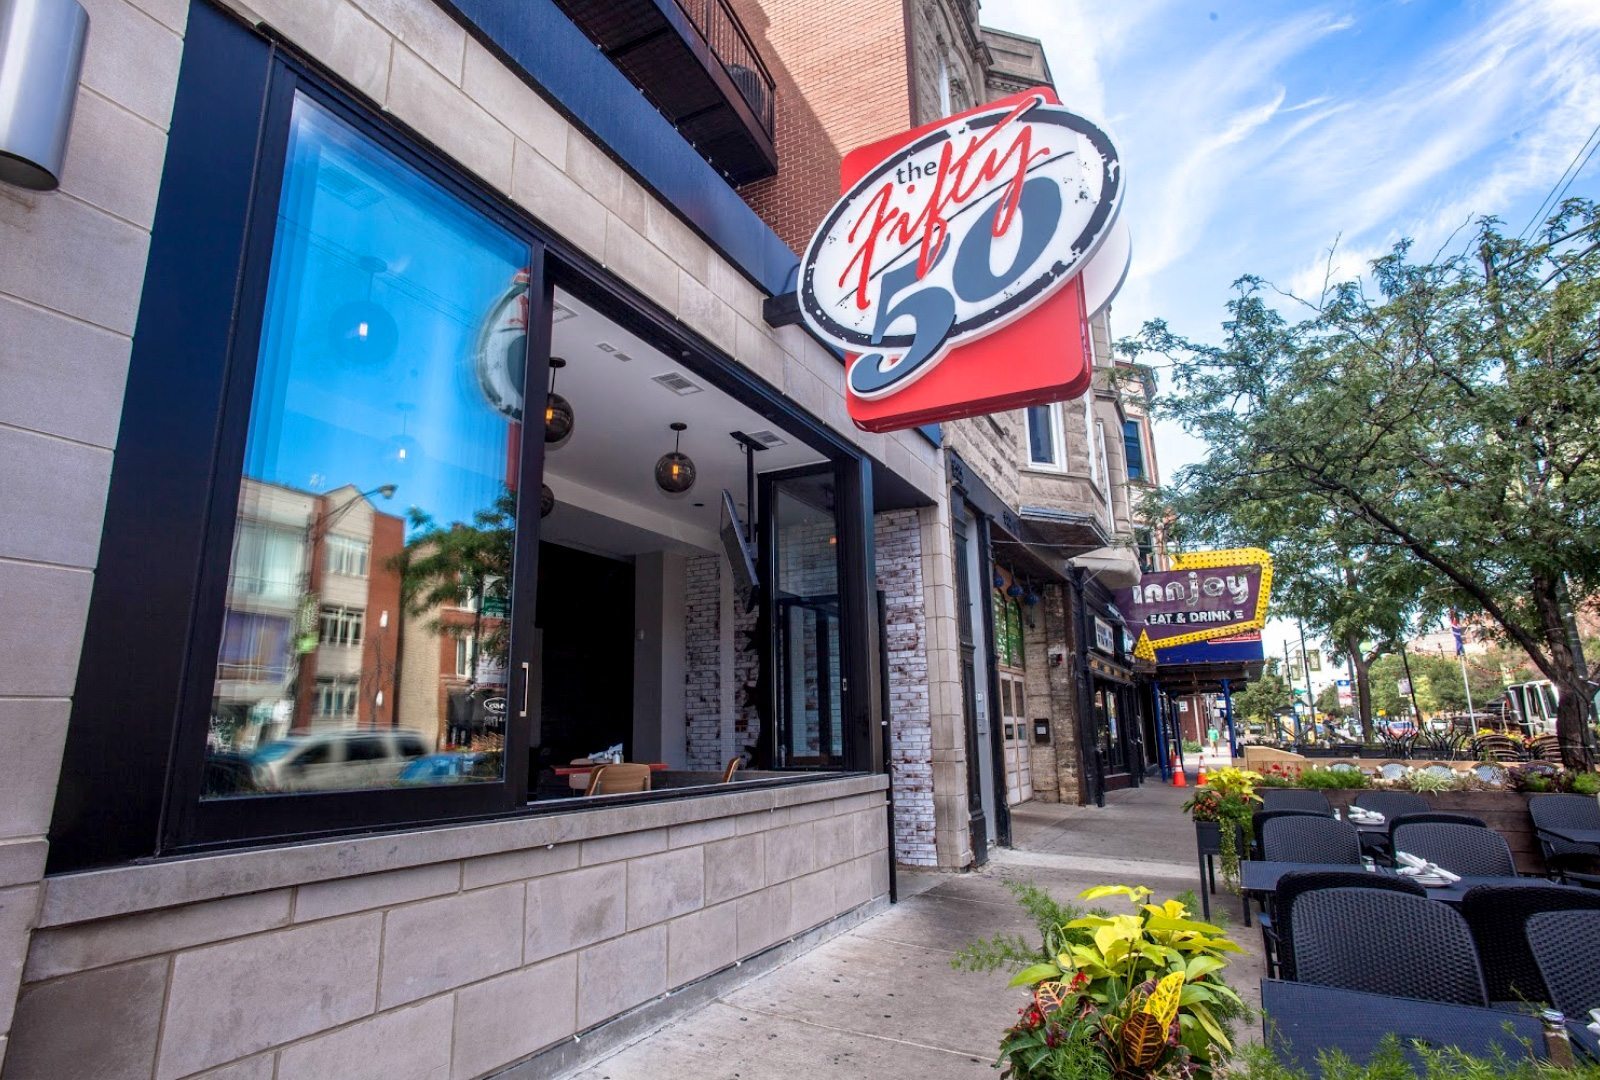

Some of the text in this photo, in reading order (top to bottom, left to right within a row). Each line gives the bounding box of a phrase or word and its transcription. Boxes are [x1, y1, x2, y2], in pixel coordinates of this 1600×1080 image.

[838, 97, 1050, 310] Fifty
[896, 159, 937, 185] the
[851, 176, 1062, 393] 50
[1149, 613, 1173, 625] EAT
[1176, 613, 1186, 624] &
[1189, 610, 1232, 623] DRINK
